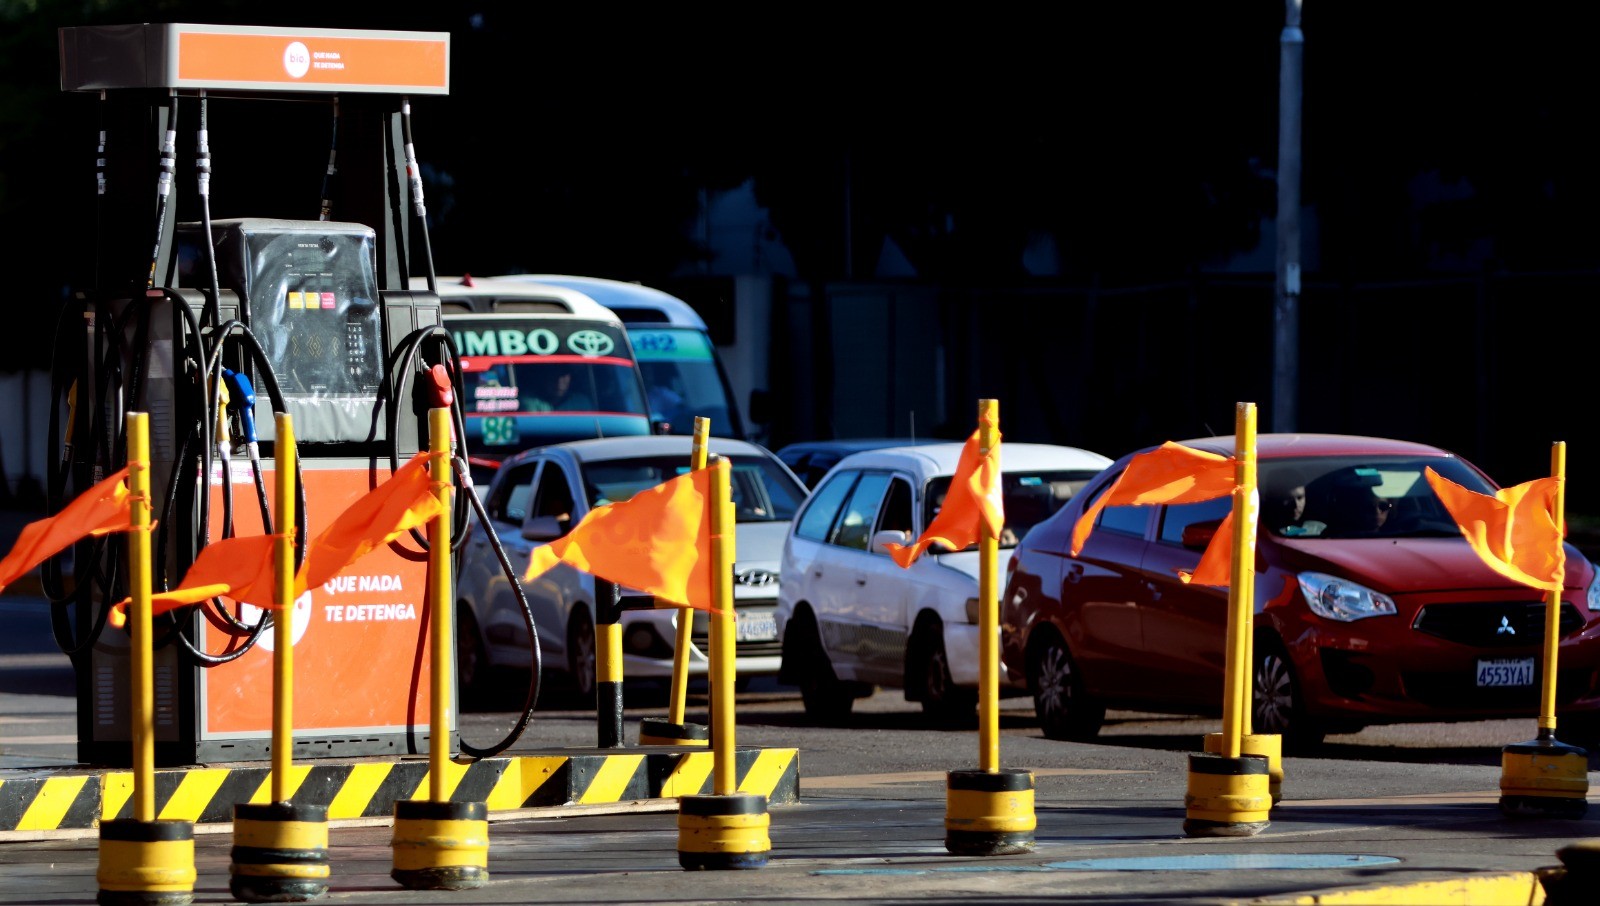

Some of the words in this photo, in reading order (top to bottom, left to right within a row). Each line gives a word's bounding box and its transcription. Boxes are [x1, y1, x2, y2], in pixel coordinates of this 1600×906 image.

[324, 576, 357, 594] QUE
[359, 574, 402, 592] NADA
[325, 606, 343, 621] TE
[346, 604, 415, 621] DETENGA
[1479, 666, 1530, 685] 4553YAI
